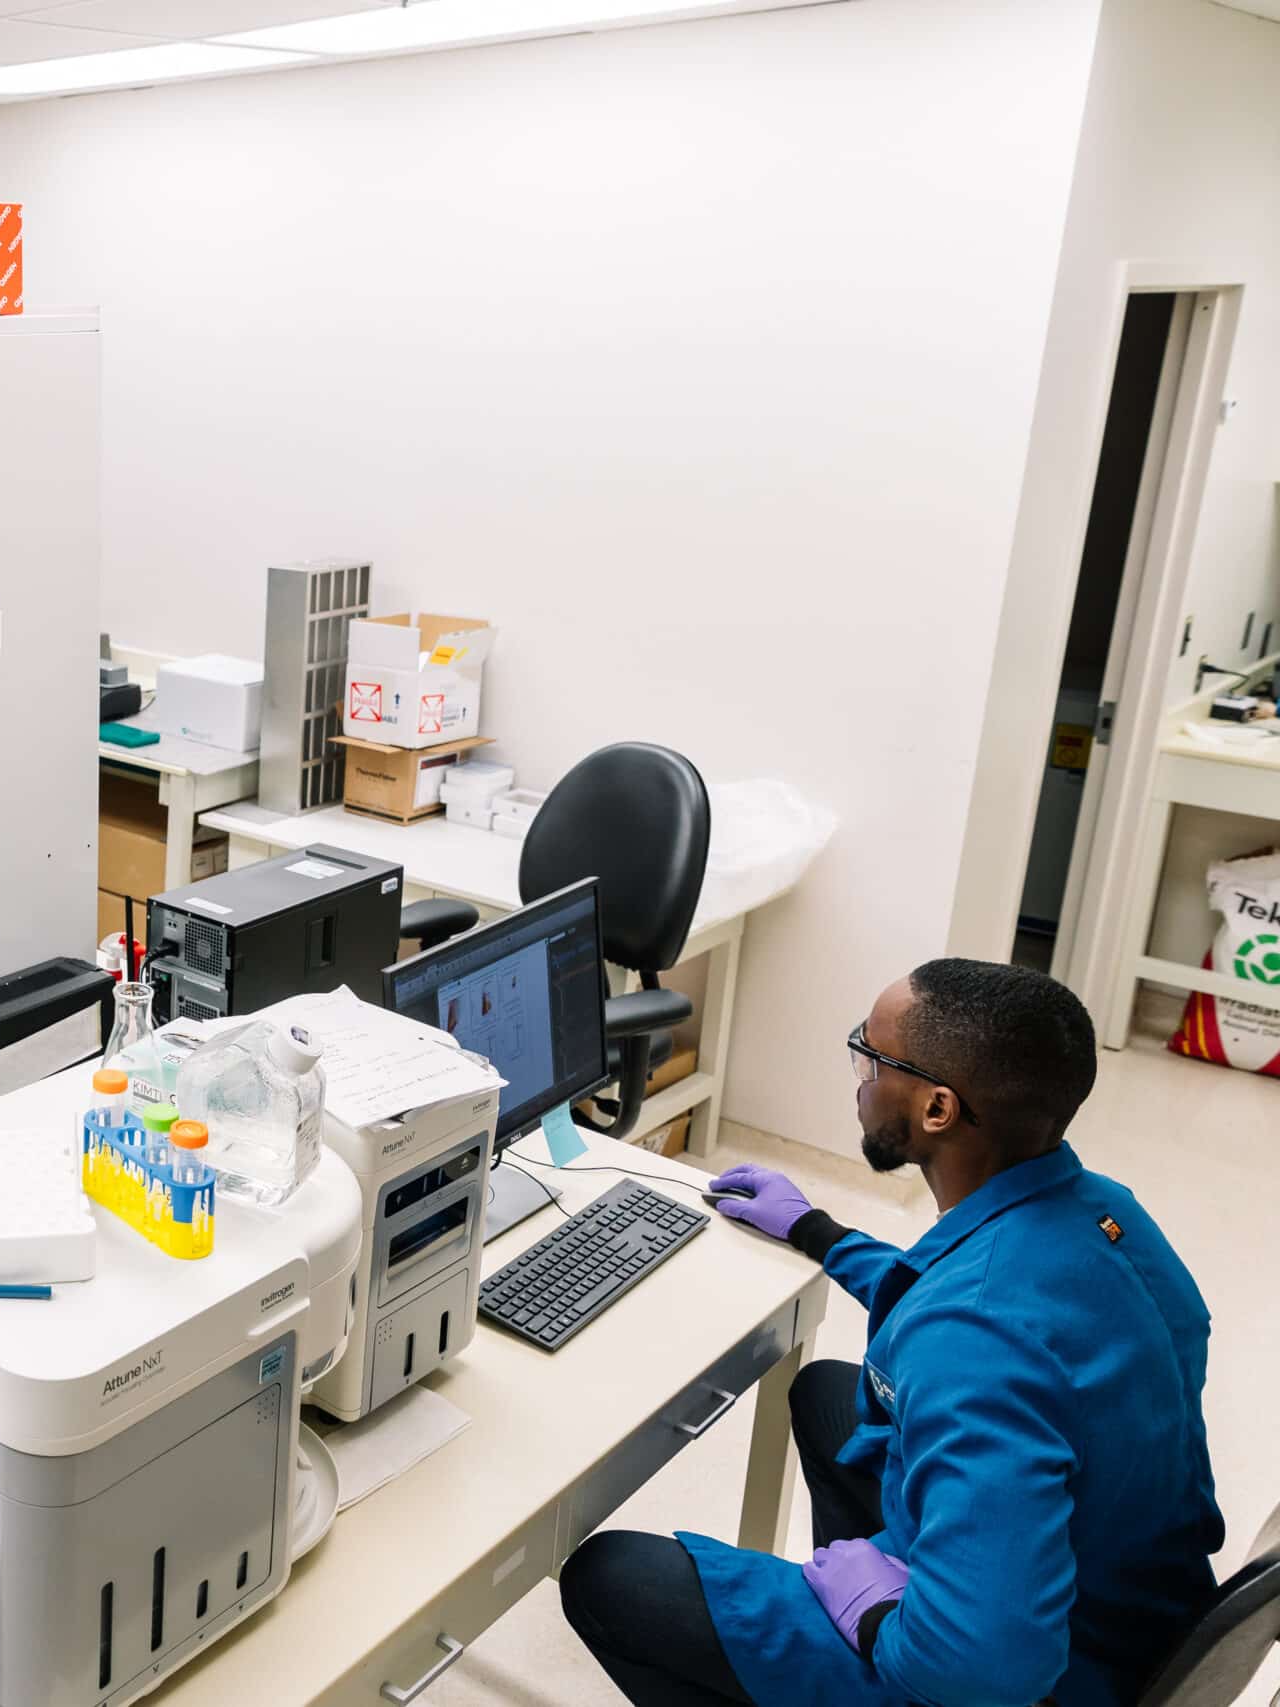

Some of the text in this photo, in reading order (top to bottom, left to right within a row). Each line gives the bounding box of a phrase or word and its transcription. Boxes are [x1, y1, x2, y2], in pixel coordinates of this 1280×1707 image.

[261, 1282, 295, 1307] invitrogen
[103, 1365, 141, 1396] Attune
[142, 1349, 163, 1374] NxT
